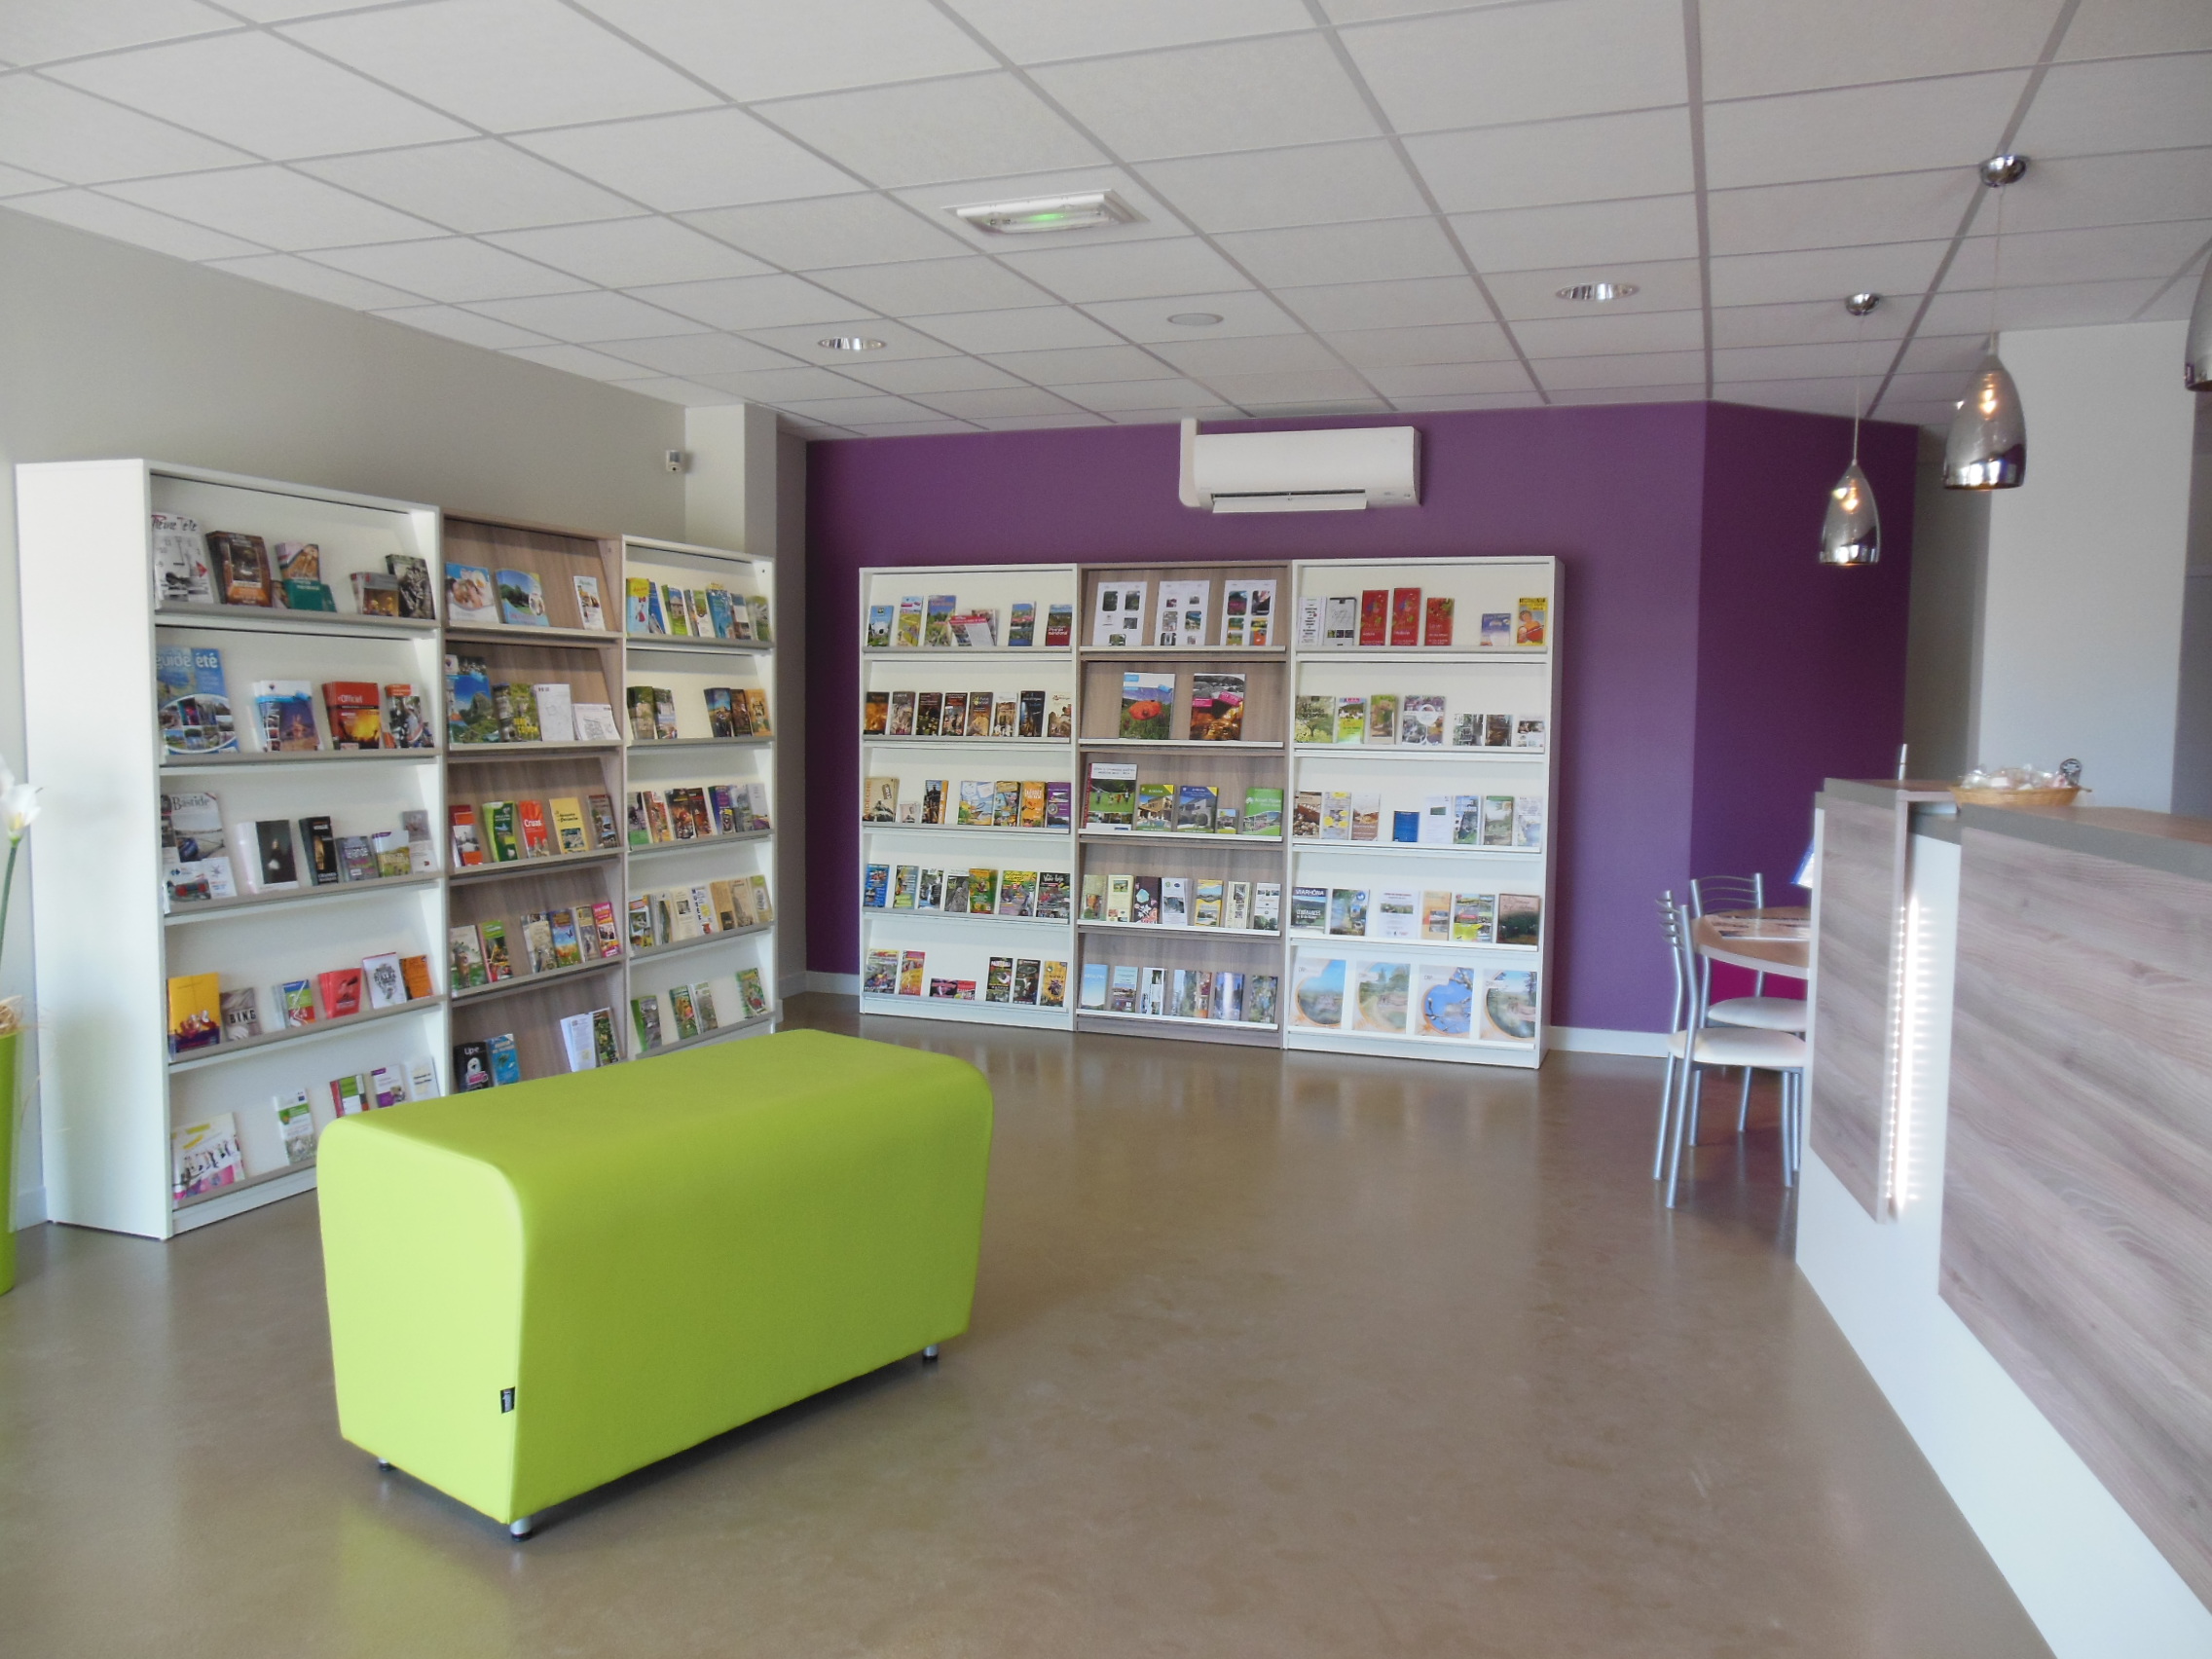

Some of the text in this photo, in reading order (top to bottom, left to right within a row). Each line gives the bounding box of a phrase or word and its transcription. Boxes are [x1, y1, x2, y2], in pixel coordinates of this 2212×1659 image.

[196, 652, 218, 669] été
[171, 795, 210, 811] Bastide
[229, 1009, 257, 1025] BING
